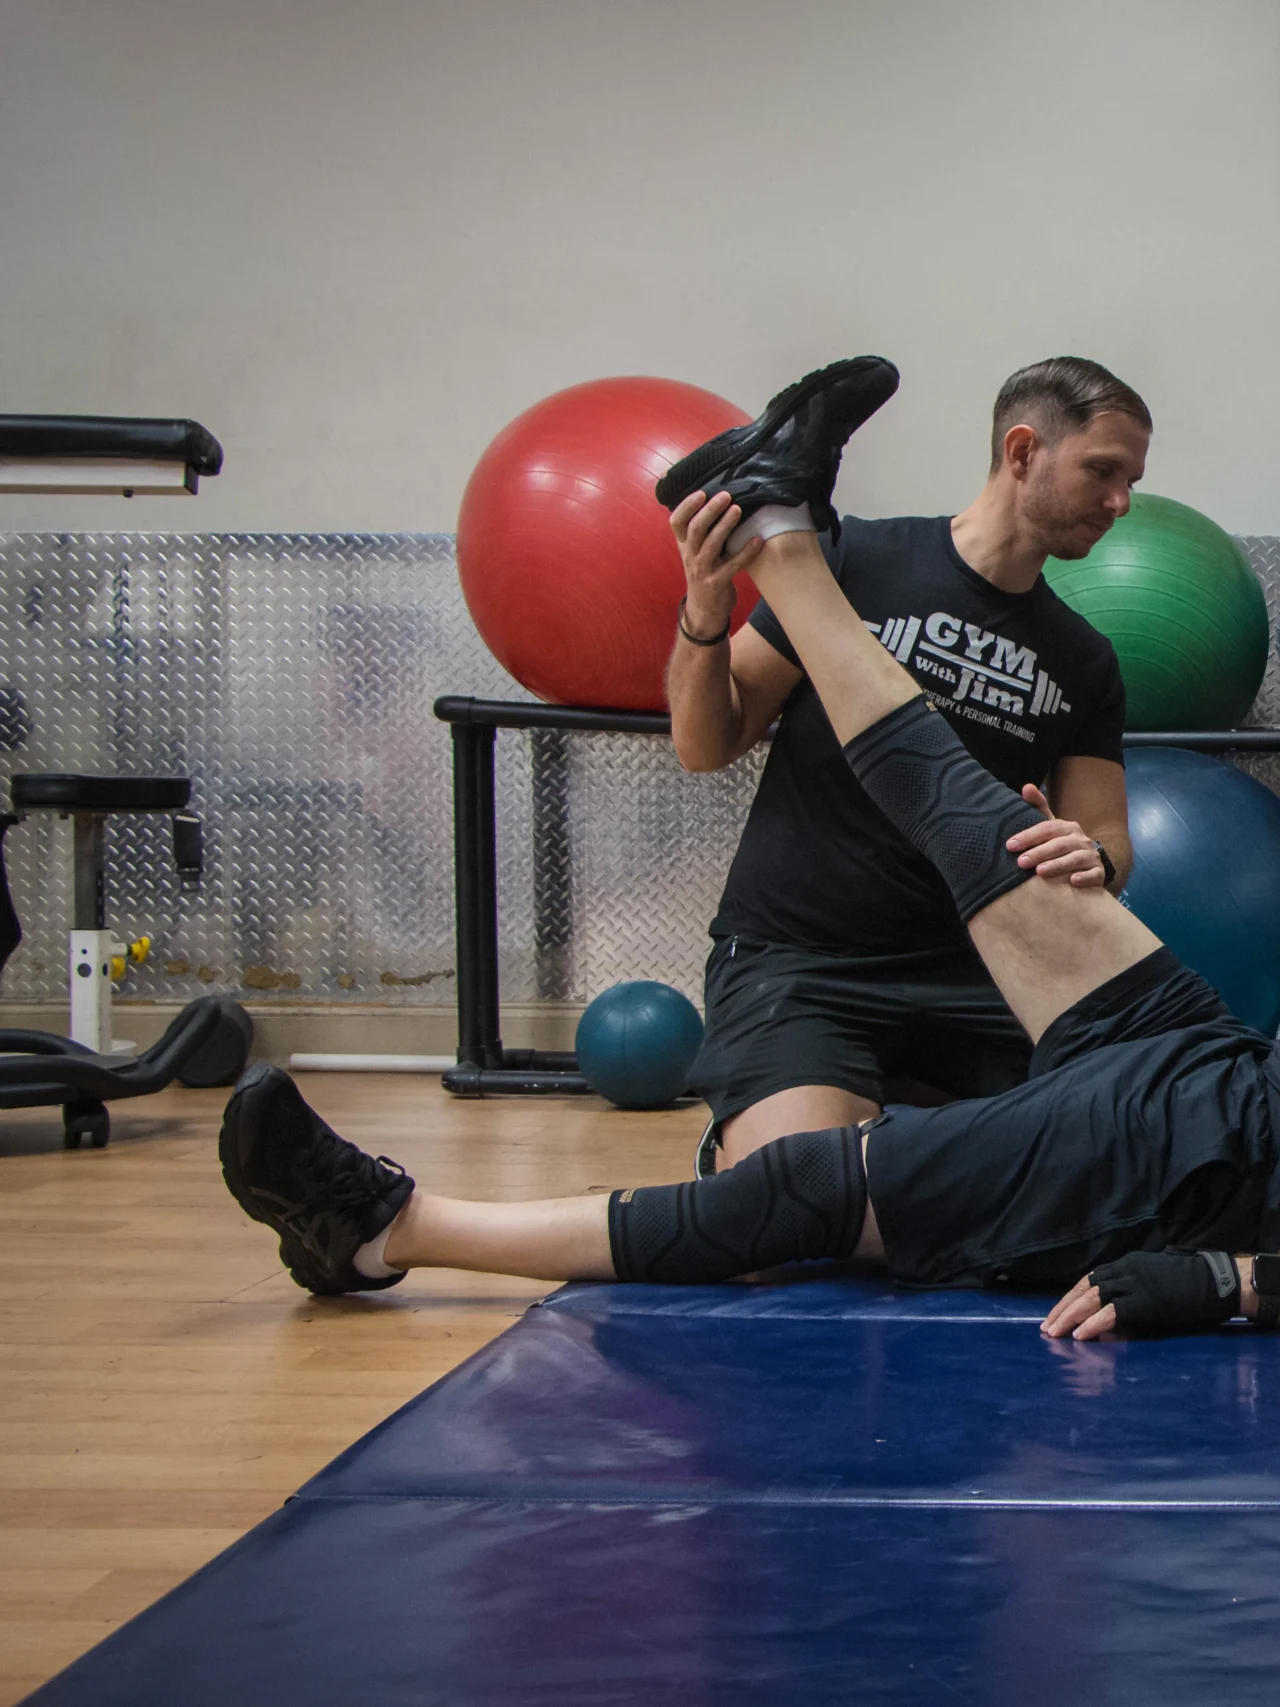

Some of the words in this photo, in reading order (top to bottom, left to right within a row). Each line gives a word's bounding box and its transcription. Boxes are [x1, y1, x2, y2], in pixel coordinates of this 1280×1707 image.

[925, 611, 1037, 682] GYM
[952, 667, 1024, 717] Jim
[955, 704, 961, 714] &
[962, 706, 1001, 729] PERSONAL
[1003, 720, 1036, 743] TRAINING
